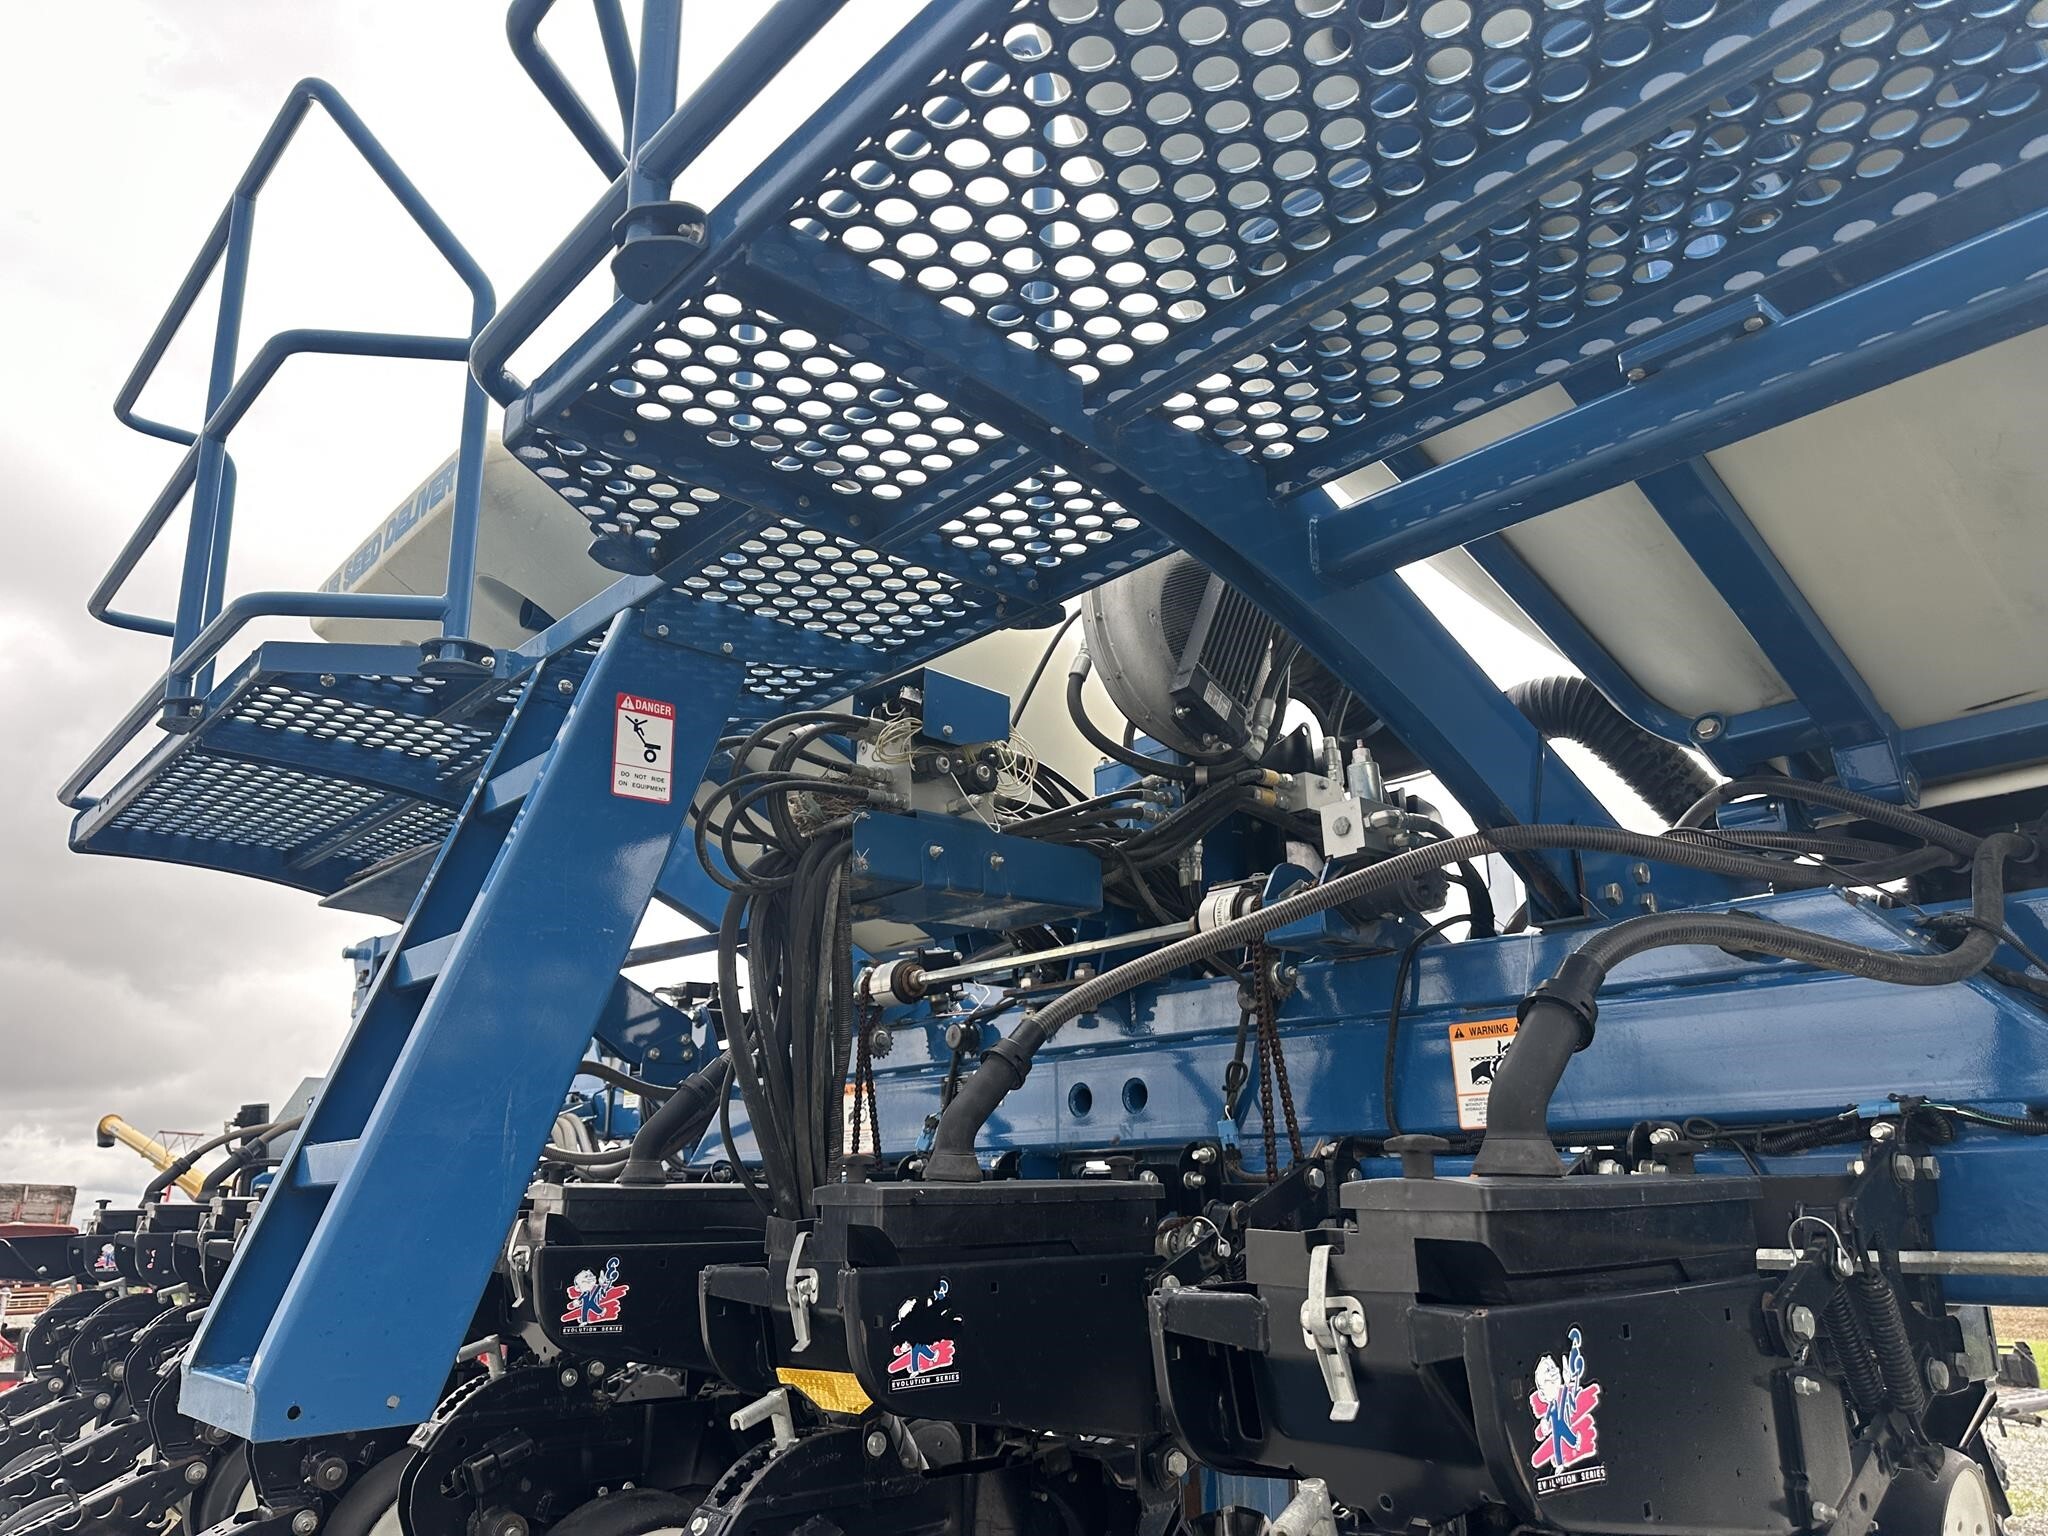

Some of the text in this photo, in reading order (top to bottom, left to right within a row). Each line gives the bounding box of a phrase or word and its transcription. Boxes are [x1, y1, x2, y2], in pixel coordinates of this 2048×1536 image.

[343, 532, 382, 591] SEED
[635, 699, 672, 716] DANGER
[620, 770, 631, 778] DO
[651, 775, 665, 784] RIDE
[632, 782, 667, 793] EQUIPMENT
[1469, 1023, 1509, 1036] WARNING
[562, 1326, 597, 1334] EVOLUTION
[891, 1374, 960, 1388] EVOLUTION SERIES
[1580, 1468, 1606, 1481] SERIES
